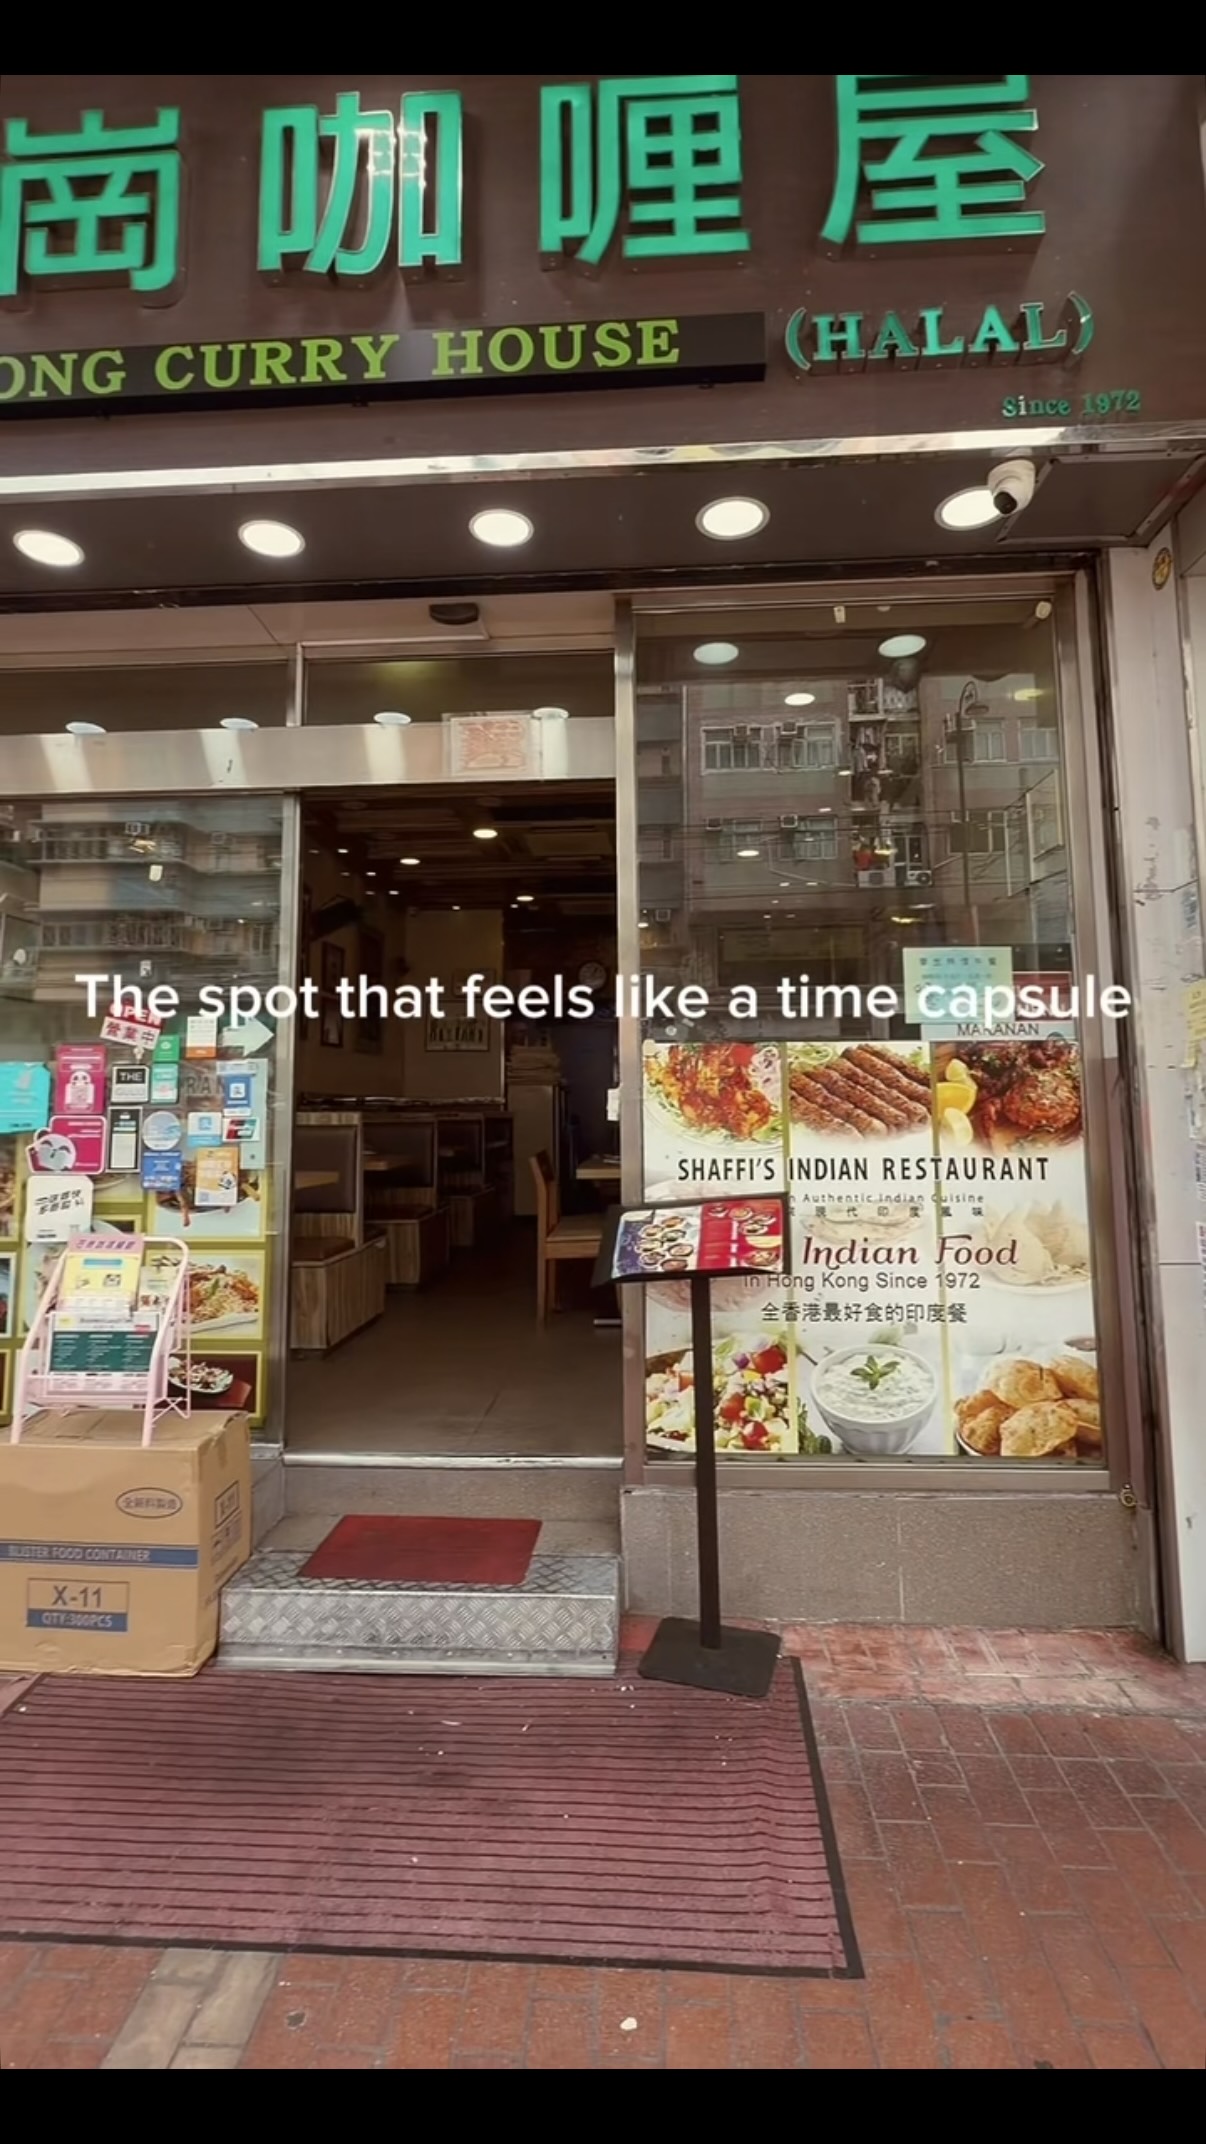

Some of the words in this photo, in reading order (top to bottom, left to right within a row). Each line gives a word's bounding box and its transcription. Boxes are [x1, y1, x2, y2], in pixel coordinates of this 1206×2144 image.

[786, 291, 1094, 371] (HALAL)
[155, 334, 399, 390] CURRY
[432, 318, 680, 377] HOUSE
[1002, 395, 1071, 418] Since
[1083, 389, 1141, 416] 1972
[677, 1157, 776, 1181] SHAFFI'S
[788, 1157, 868, 1181] INDIAN
[882, 1156, 1049, 1181] RESTAURANT
[803, 1192, 873, 1204] Authentic
[878, 1193, 925, 1204] Indian
[931, 1193, 985, 1205] Cuisine
[802, 1236, 919, 1271] Indian
[935, 1234, 1018, 1265] Food
[767, 1272, 815, 1293] Hong
[821, 1272, 869, 1293] Kong
[875, 1271, 928, 1289] Since
[935, 1272, 981, 1289] 1972
[761, 1302, 968, 1323] 全香港最好食的印度餐
[52, 1547, 83, 1559] FOOD
[84, 1549, 151, 1562] CONTAINER
[51, 1585, 102, 1608] X-11
